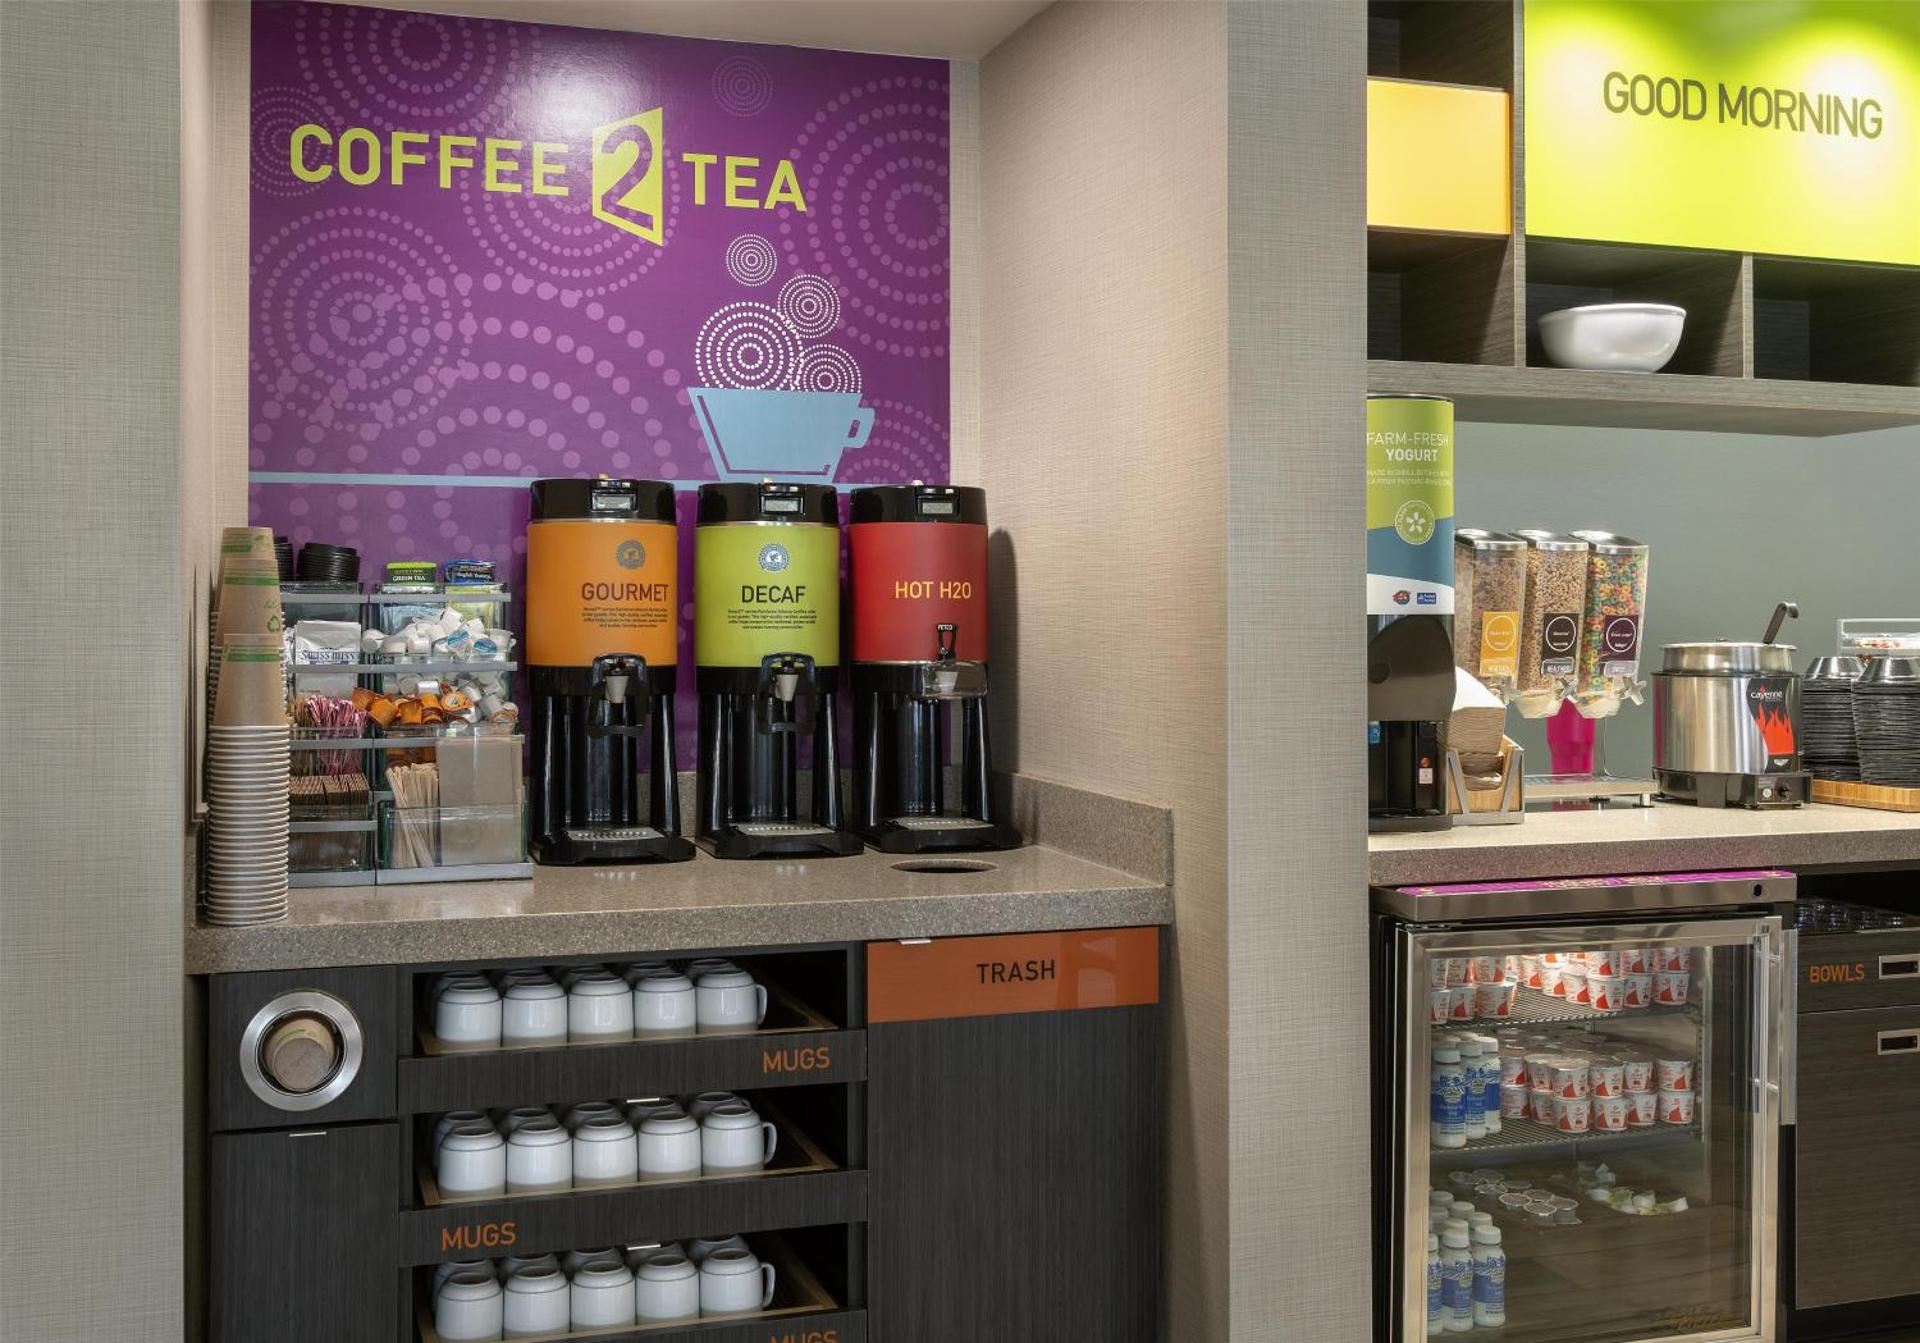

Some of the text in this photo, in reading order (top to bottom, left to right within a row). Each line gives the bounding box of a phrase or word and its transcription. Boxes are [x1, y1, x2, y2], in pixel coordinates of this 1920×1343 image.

[1603, 71, 1883, 139] GOOD MORNING
[290, 123, 808, 222] COFFEE 2 TEA
[1366, 431, 1449, 447] FARM-FRESH
[1386, 448, 1438, 462] YOGURT
[582, 582, 669, 602] GOURMET
[742, 585, 806, 603] DECAF
[895, 580, 934, 599] HOT
[976, 959, 1056, 984] TRASH
[1810, 963, 1865, 983] BOWLS
[763, 1046, 831, 1074] MUGS
[442, 1221, 517, 1251] MUGS
